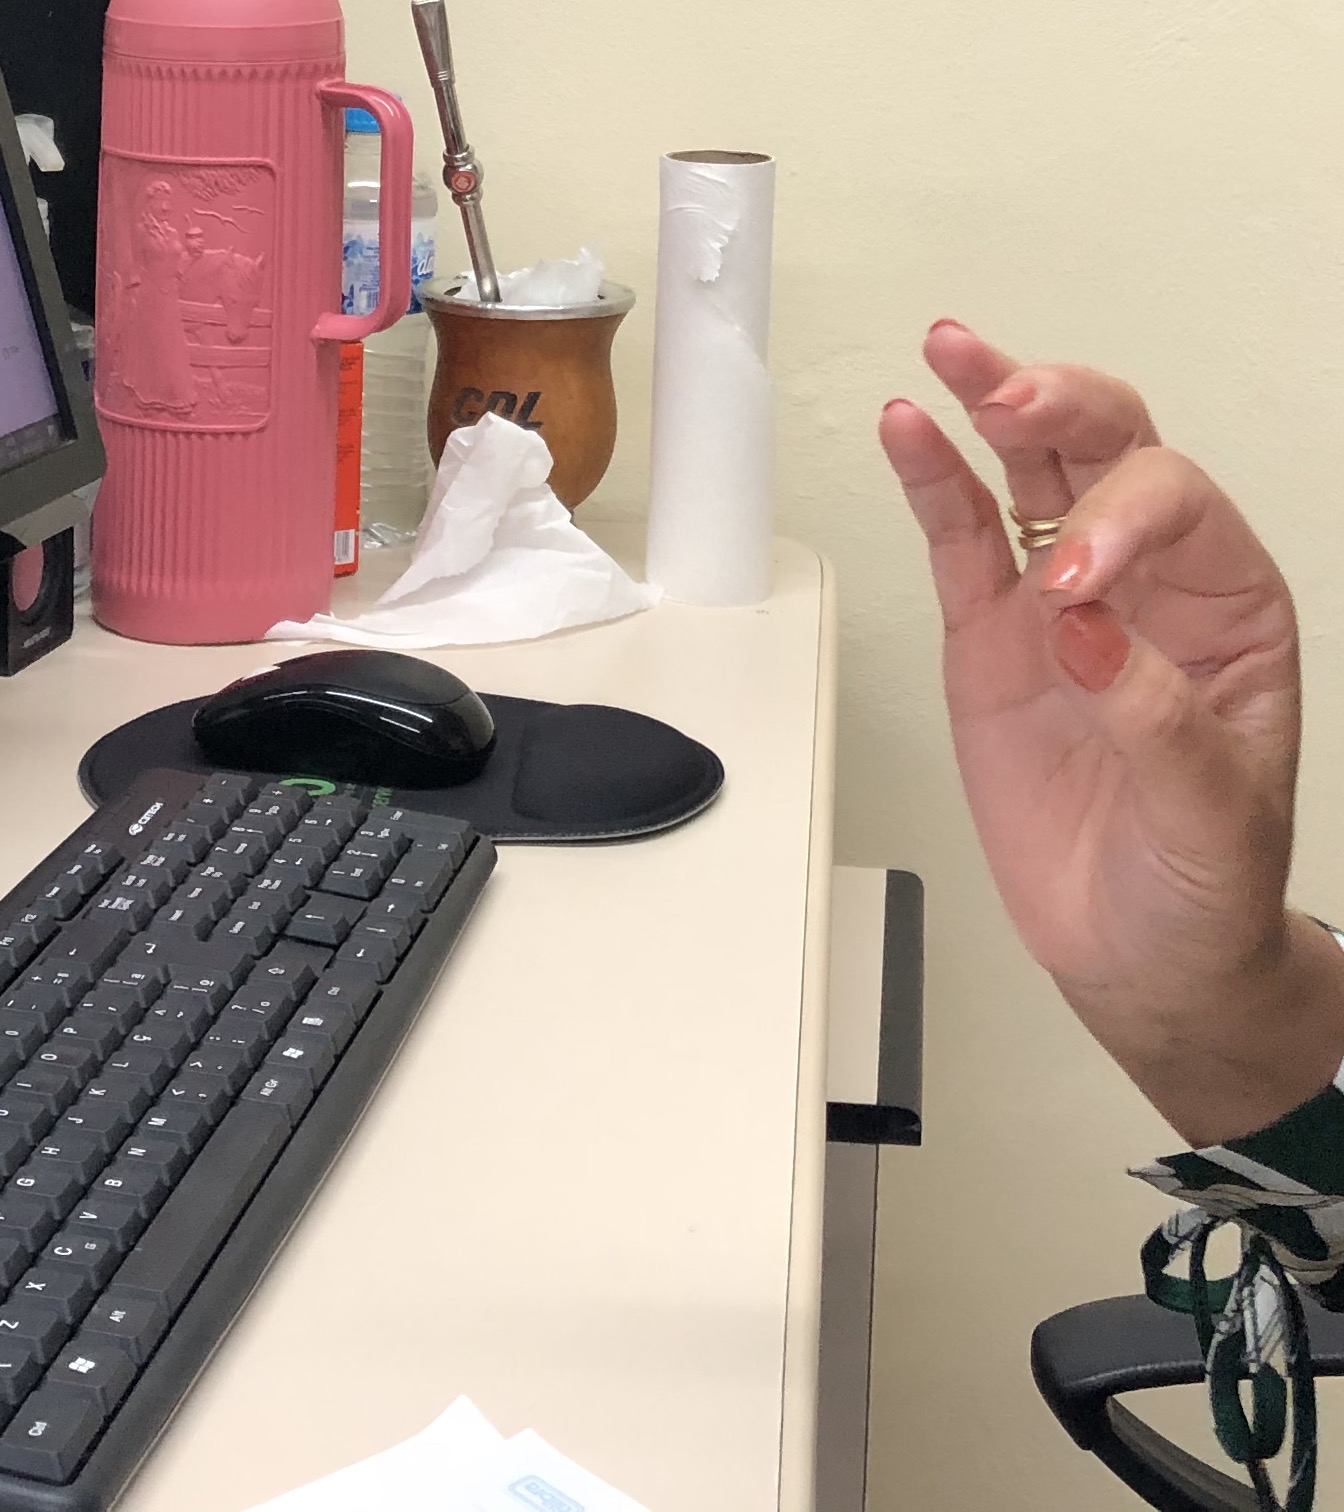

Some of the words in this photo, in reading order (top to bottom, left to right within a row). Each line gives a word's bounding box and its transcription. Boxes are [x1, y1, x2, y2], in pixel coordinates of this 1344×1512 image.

[88, 1088, 107, 1096] K
[147, 1117, 167, 1126] M
[41, 1146, 60, 1155] H
[127, 1147, 147, 1156] N
[16, 1177, 35, 1187] G
[104, 1178, 123, 1187] B
[79, 1211, 98, 1220] V
[54, 1246, 73, 1256] C
[25, 1281, 46, 1291] X
